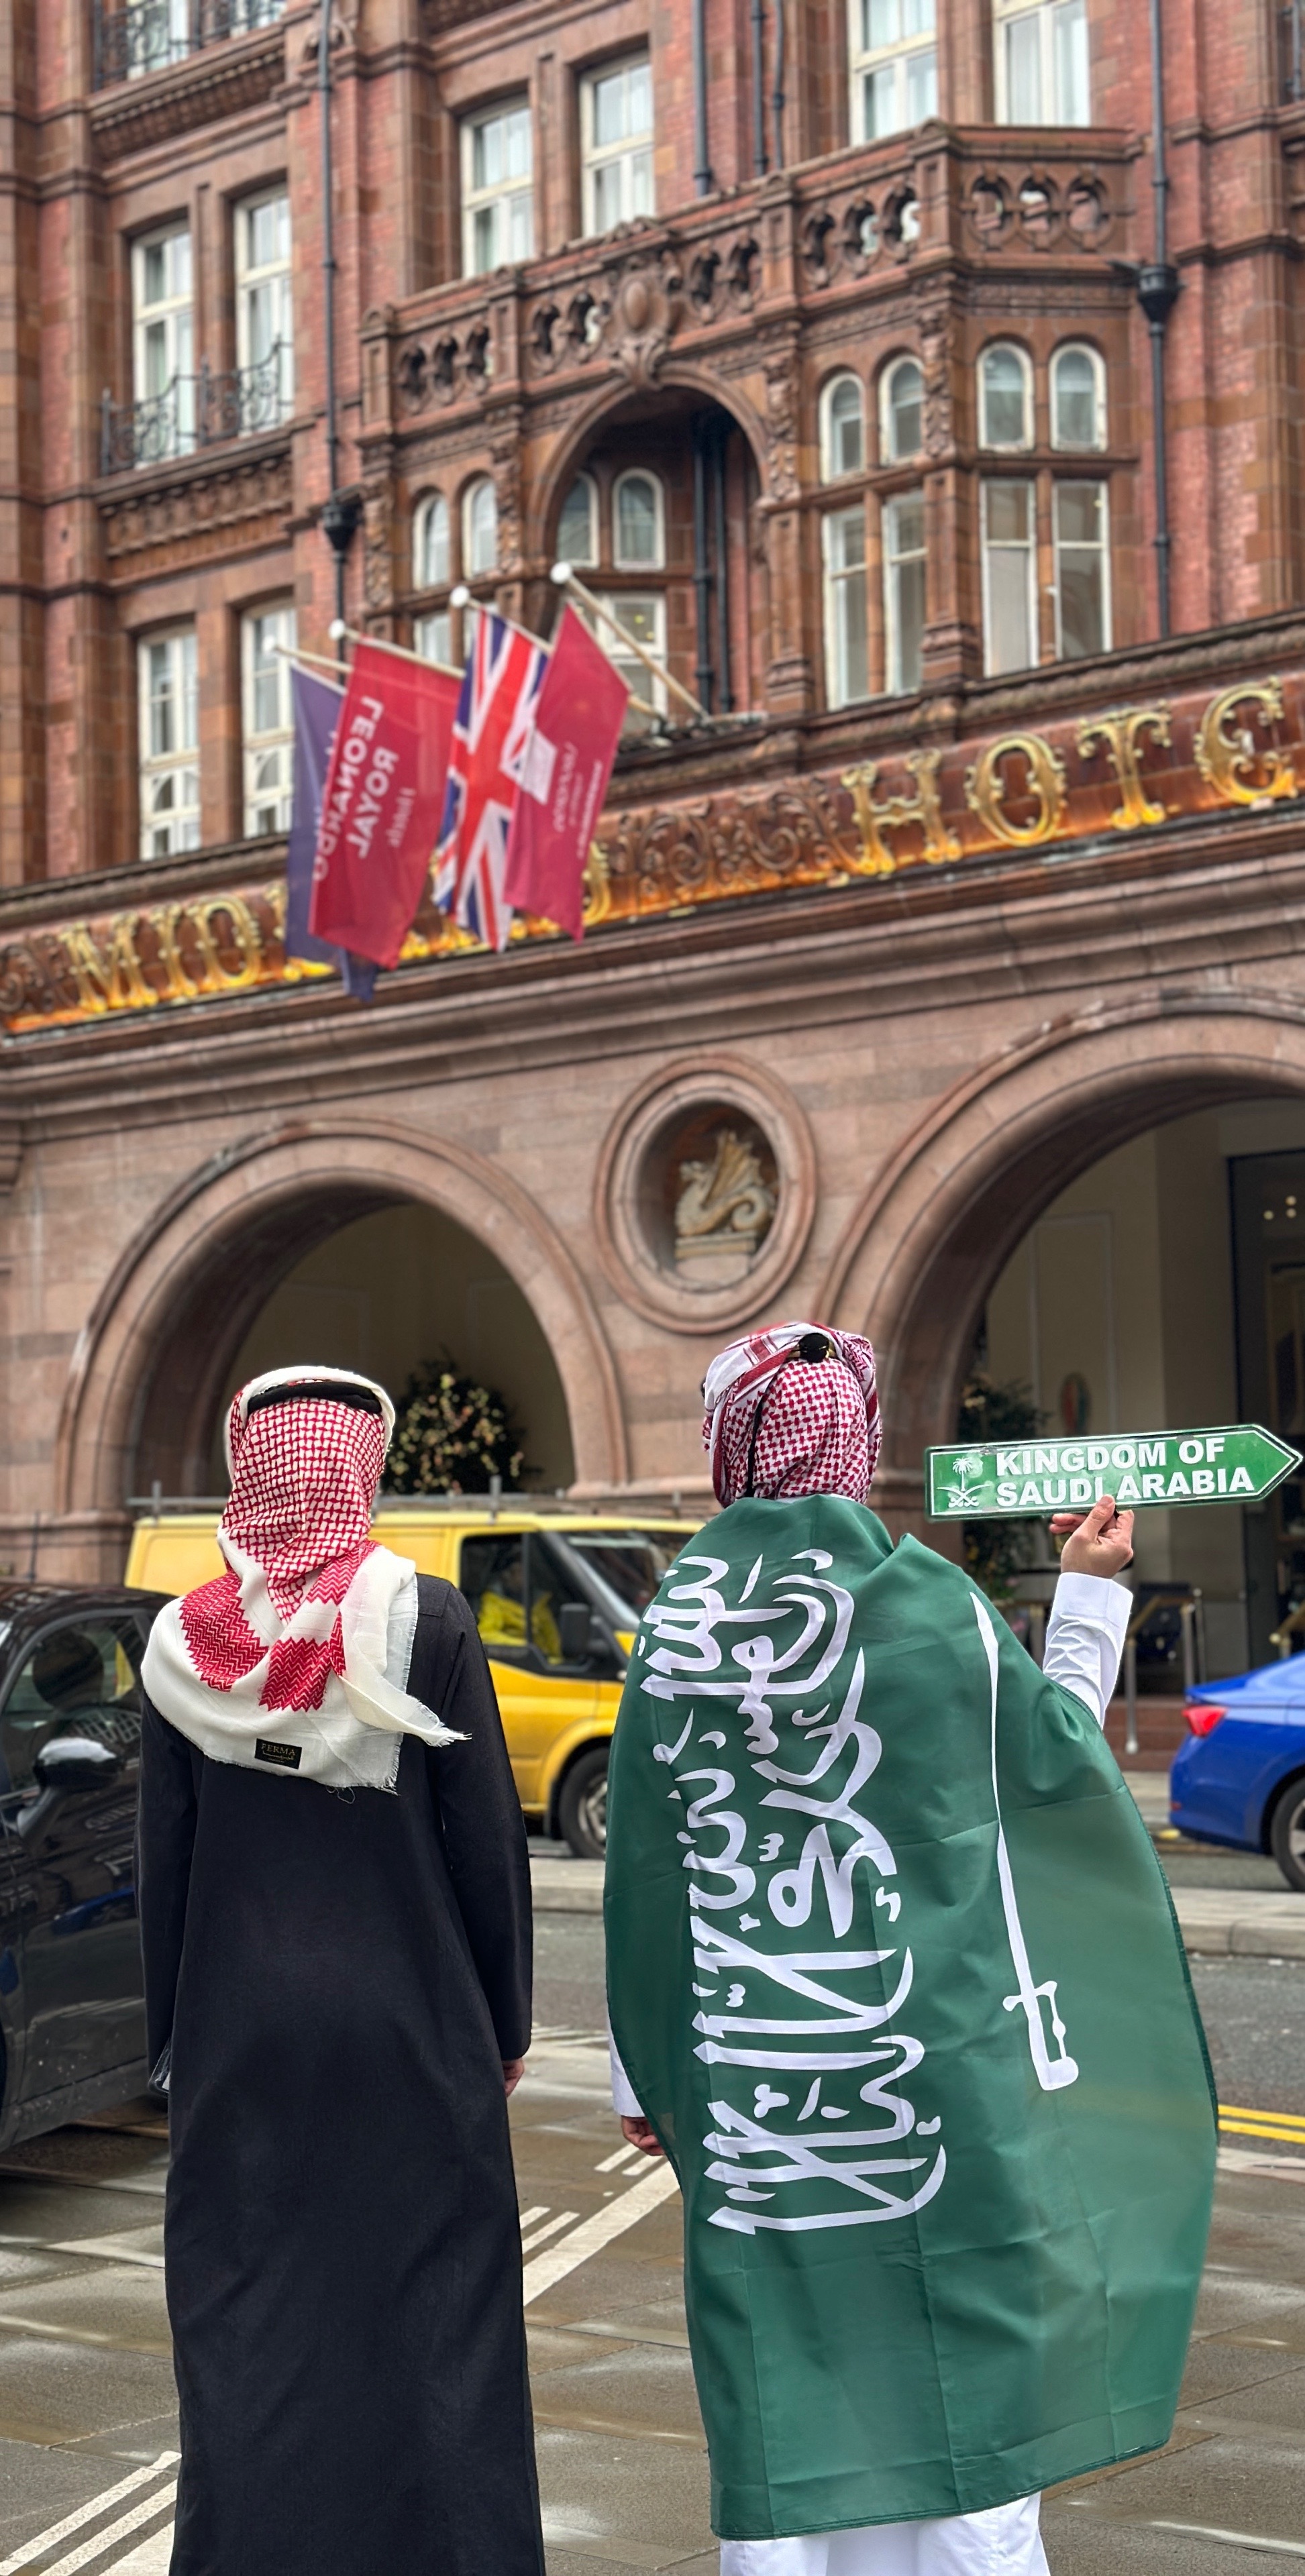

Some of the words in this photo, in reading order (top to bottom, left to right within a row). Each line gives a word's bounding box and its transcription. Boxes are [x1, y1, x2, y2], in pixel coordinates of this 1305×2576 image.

[996, 1442, 1167, 1477] KINGDOM
[1178, 1437, 1226, 1465] OF
[996, 1476, 1104, 1507] SAUDI
[1116, 1466, 1254, 1501] ARABIA
